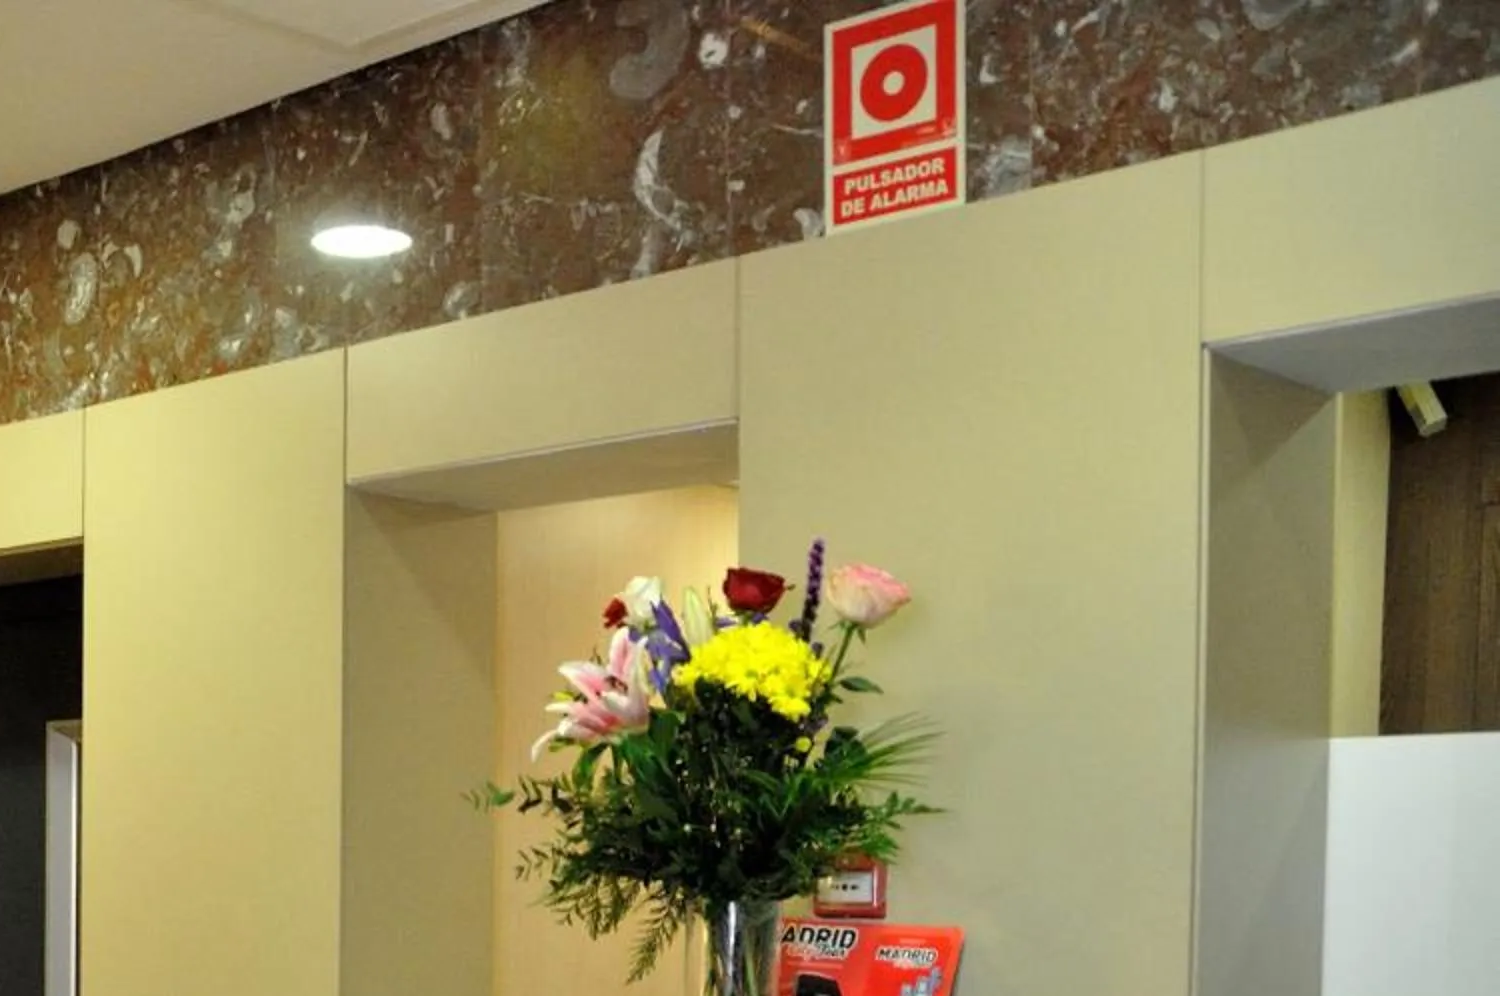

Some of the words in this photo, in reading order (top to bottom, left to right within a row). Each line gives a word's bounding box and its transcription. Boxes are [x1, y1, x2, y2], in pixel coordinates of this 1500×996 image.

[844, 158, 945, 195] PULSADOR
[841, 197, 864, 218] DE
[870, 179, 949, 211] ALARMA
[780, 925, 857, 949] ADRID
[877, 948, 938, 964] MADRID
